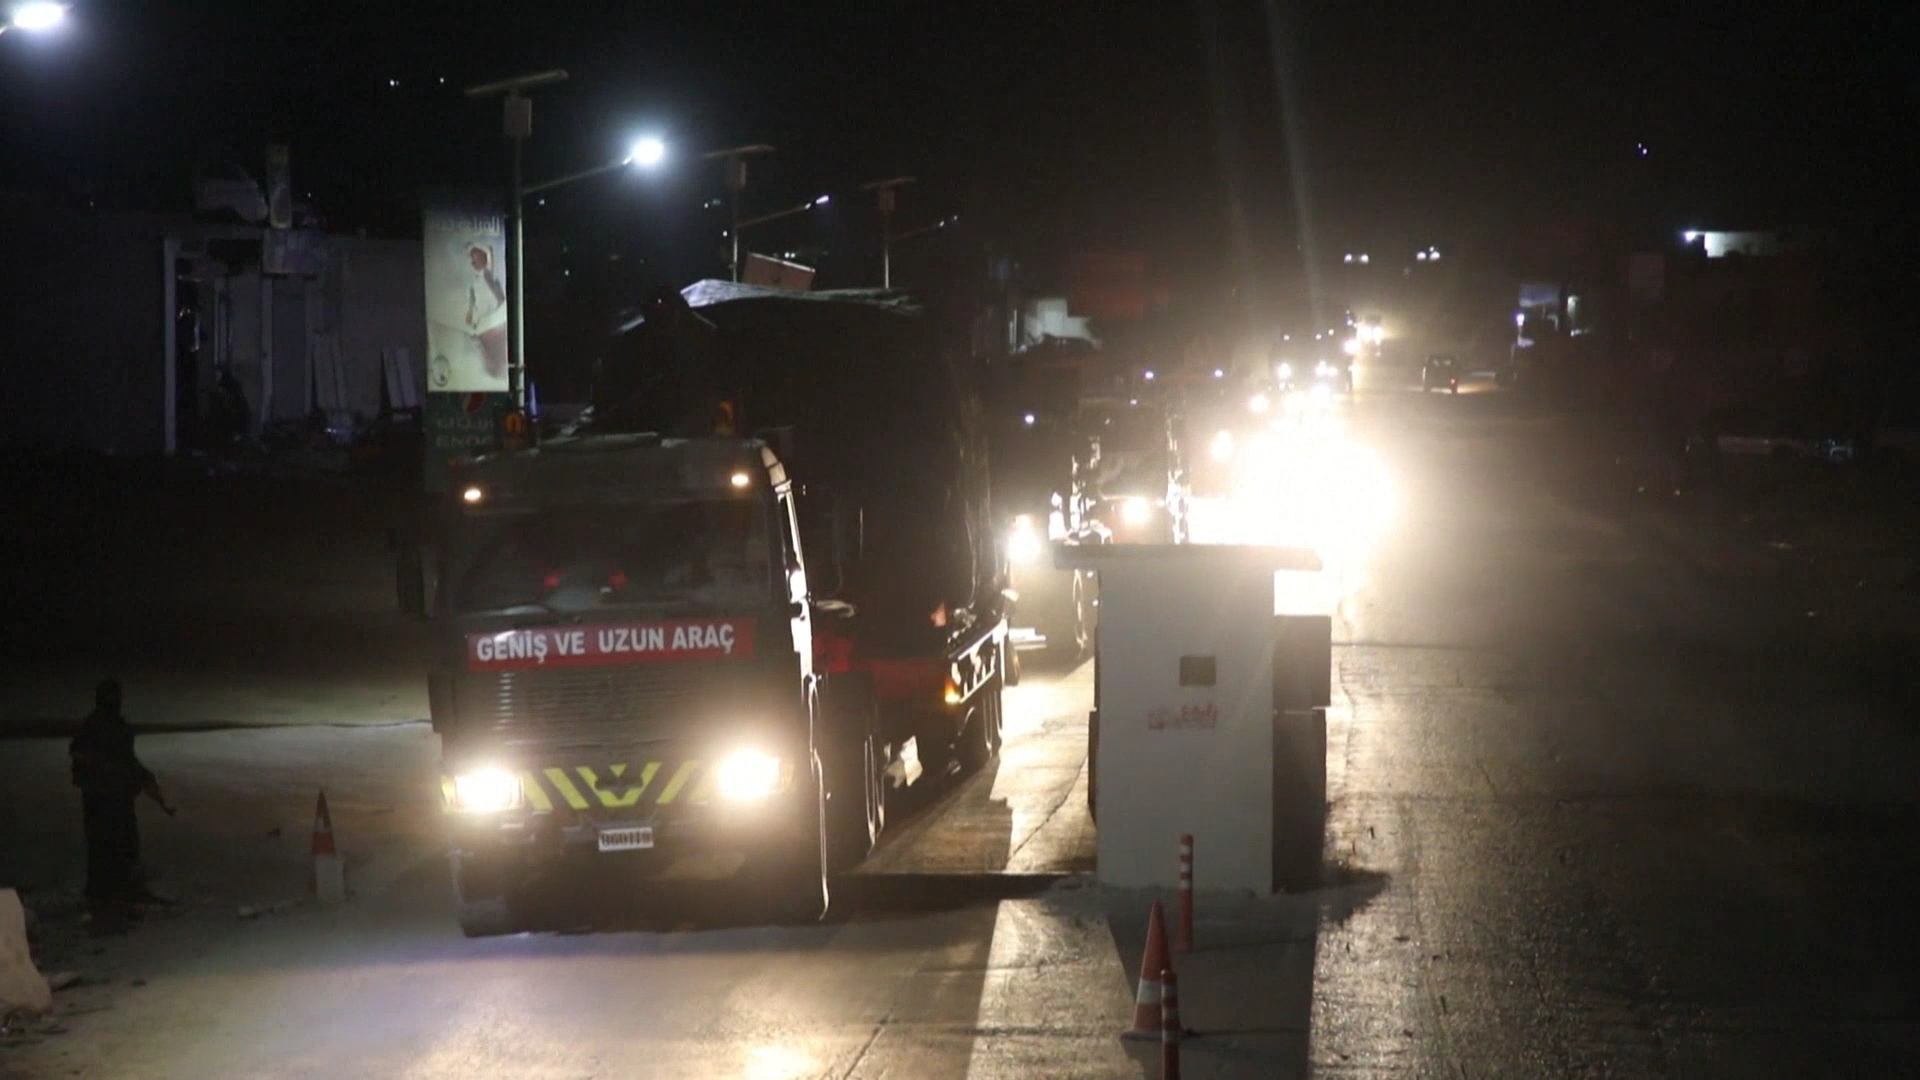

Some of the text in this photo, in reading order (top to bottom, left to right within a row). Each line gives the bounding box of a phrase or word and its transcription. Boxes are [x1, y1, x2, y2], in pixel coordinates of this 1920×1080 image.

[476, 624, 735, 664] GENİŞ VE UZUN ARAÇ
